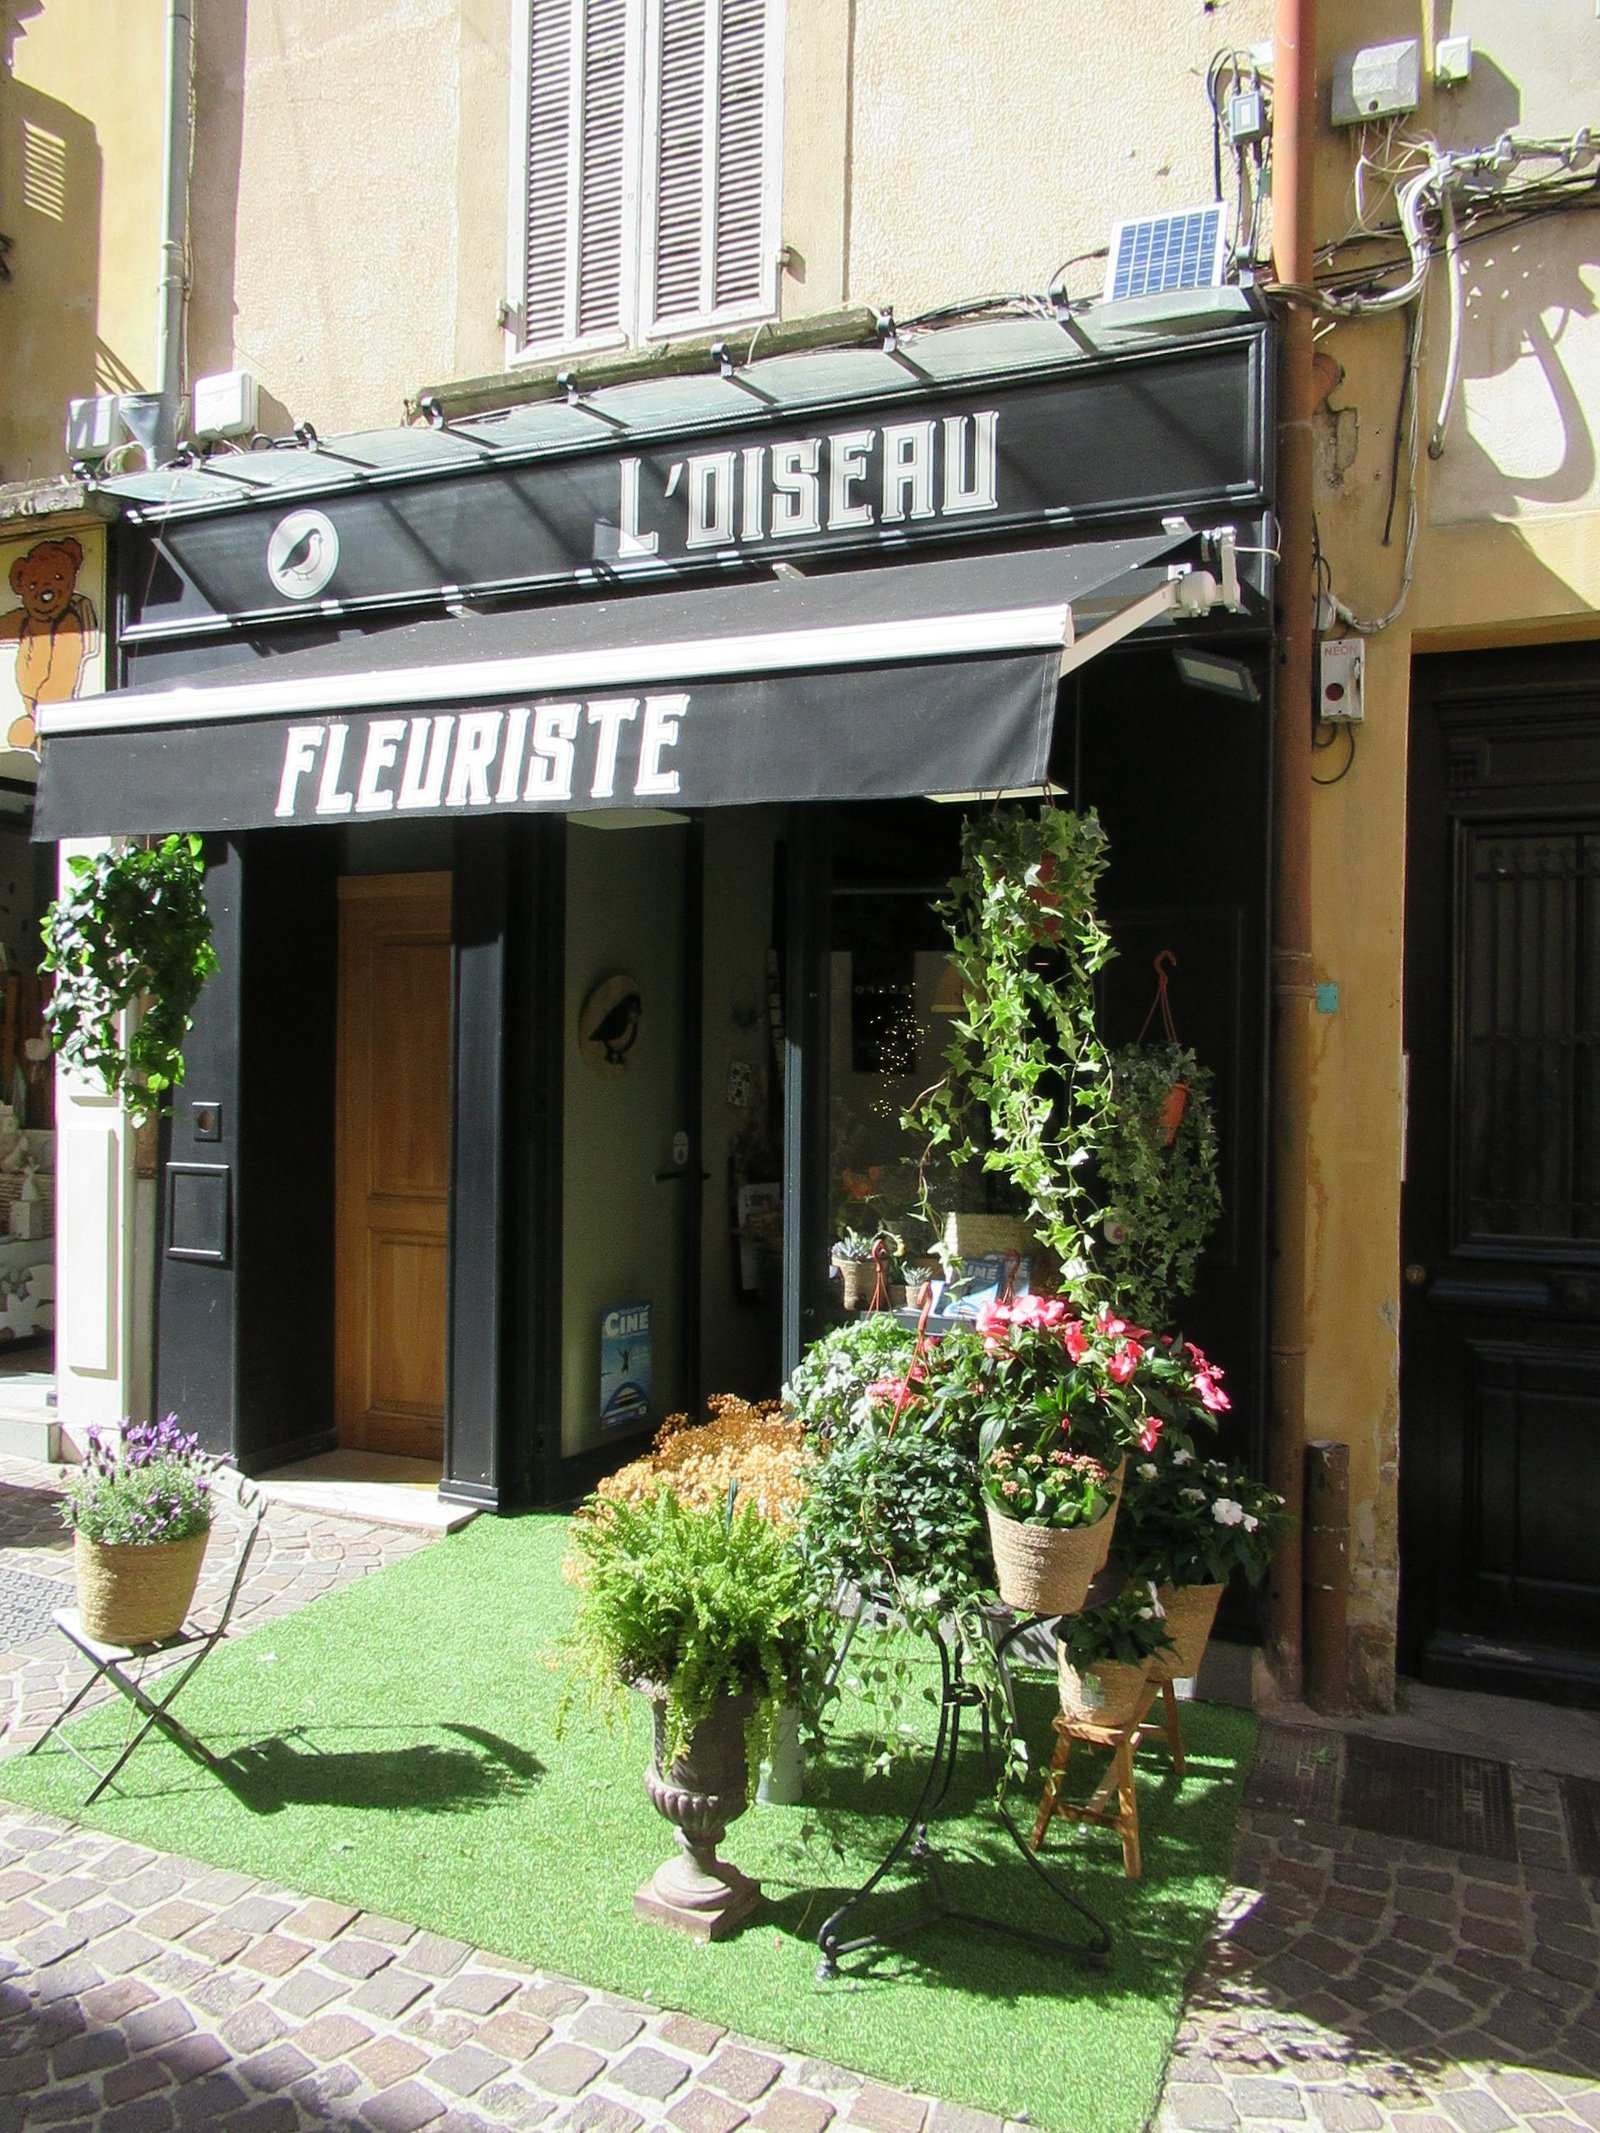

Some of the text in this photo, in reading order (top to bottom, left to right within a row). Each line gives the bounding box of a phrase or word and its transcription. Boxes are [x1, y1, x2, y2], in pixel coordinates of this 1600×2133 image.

[618, 410, 999, 559] L'OISEAU
[1325, 646, 1357, 656] NEON
[274, 693, 691, 817] FLEURISTE
